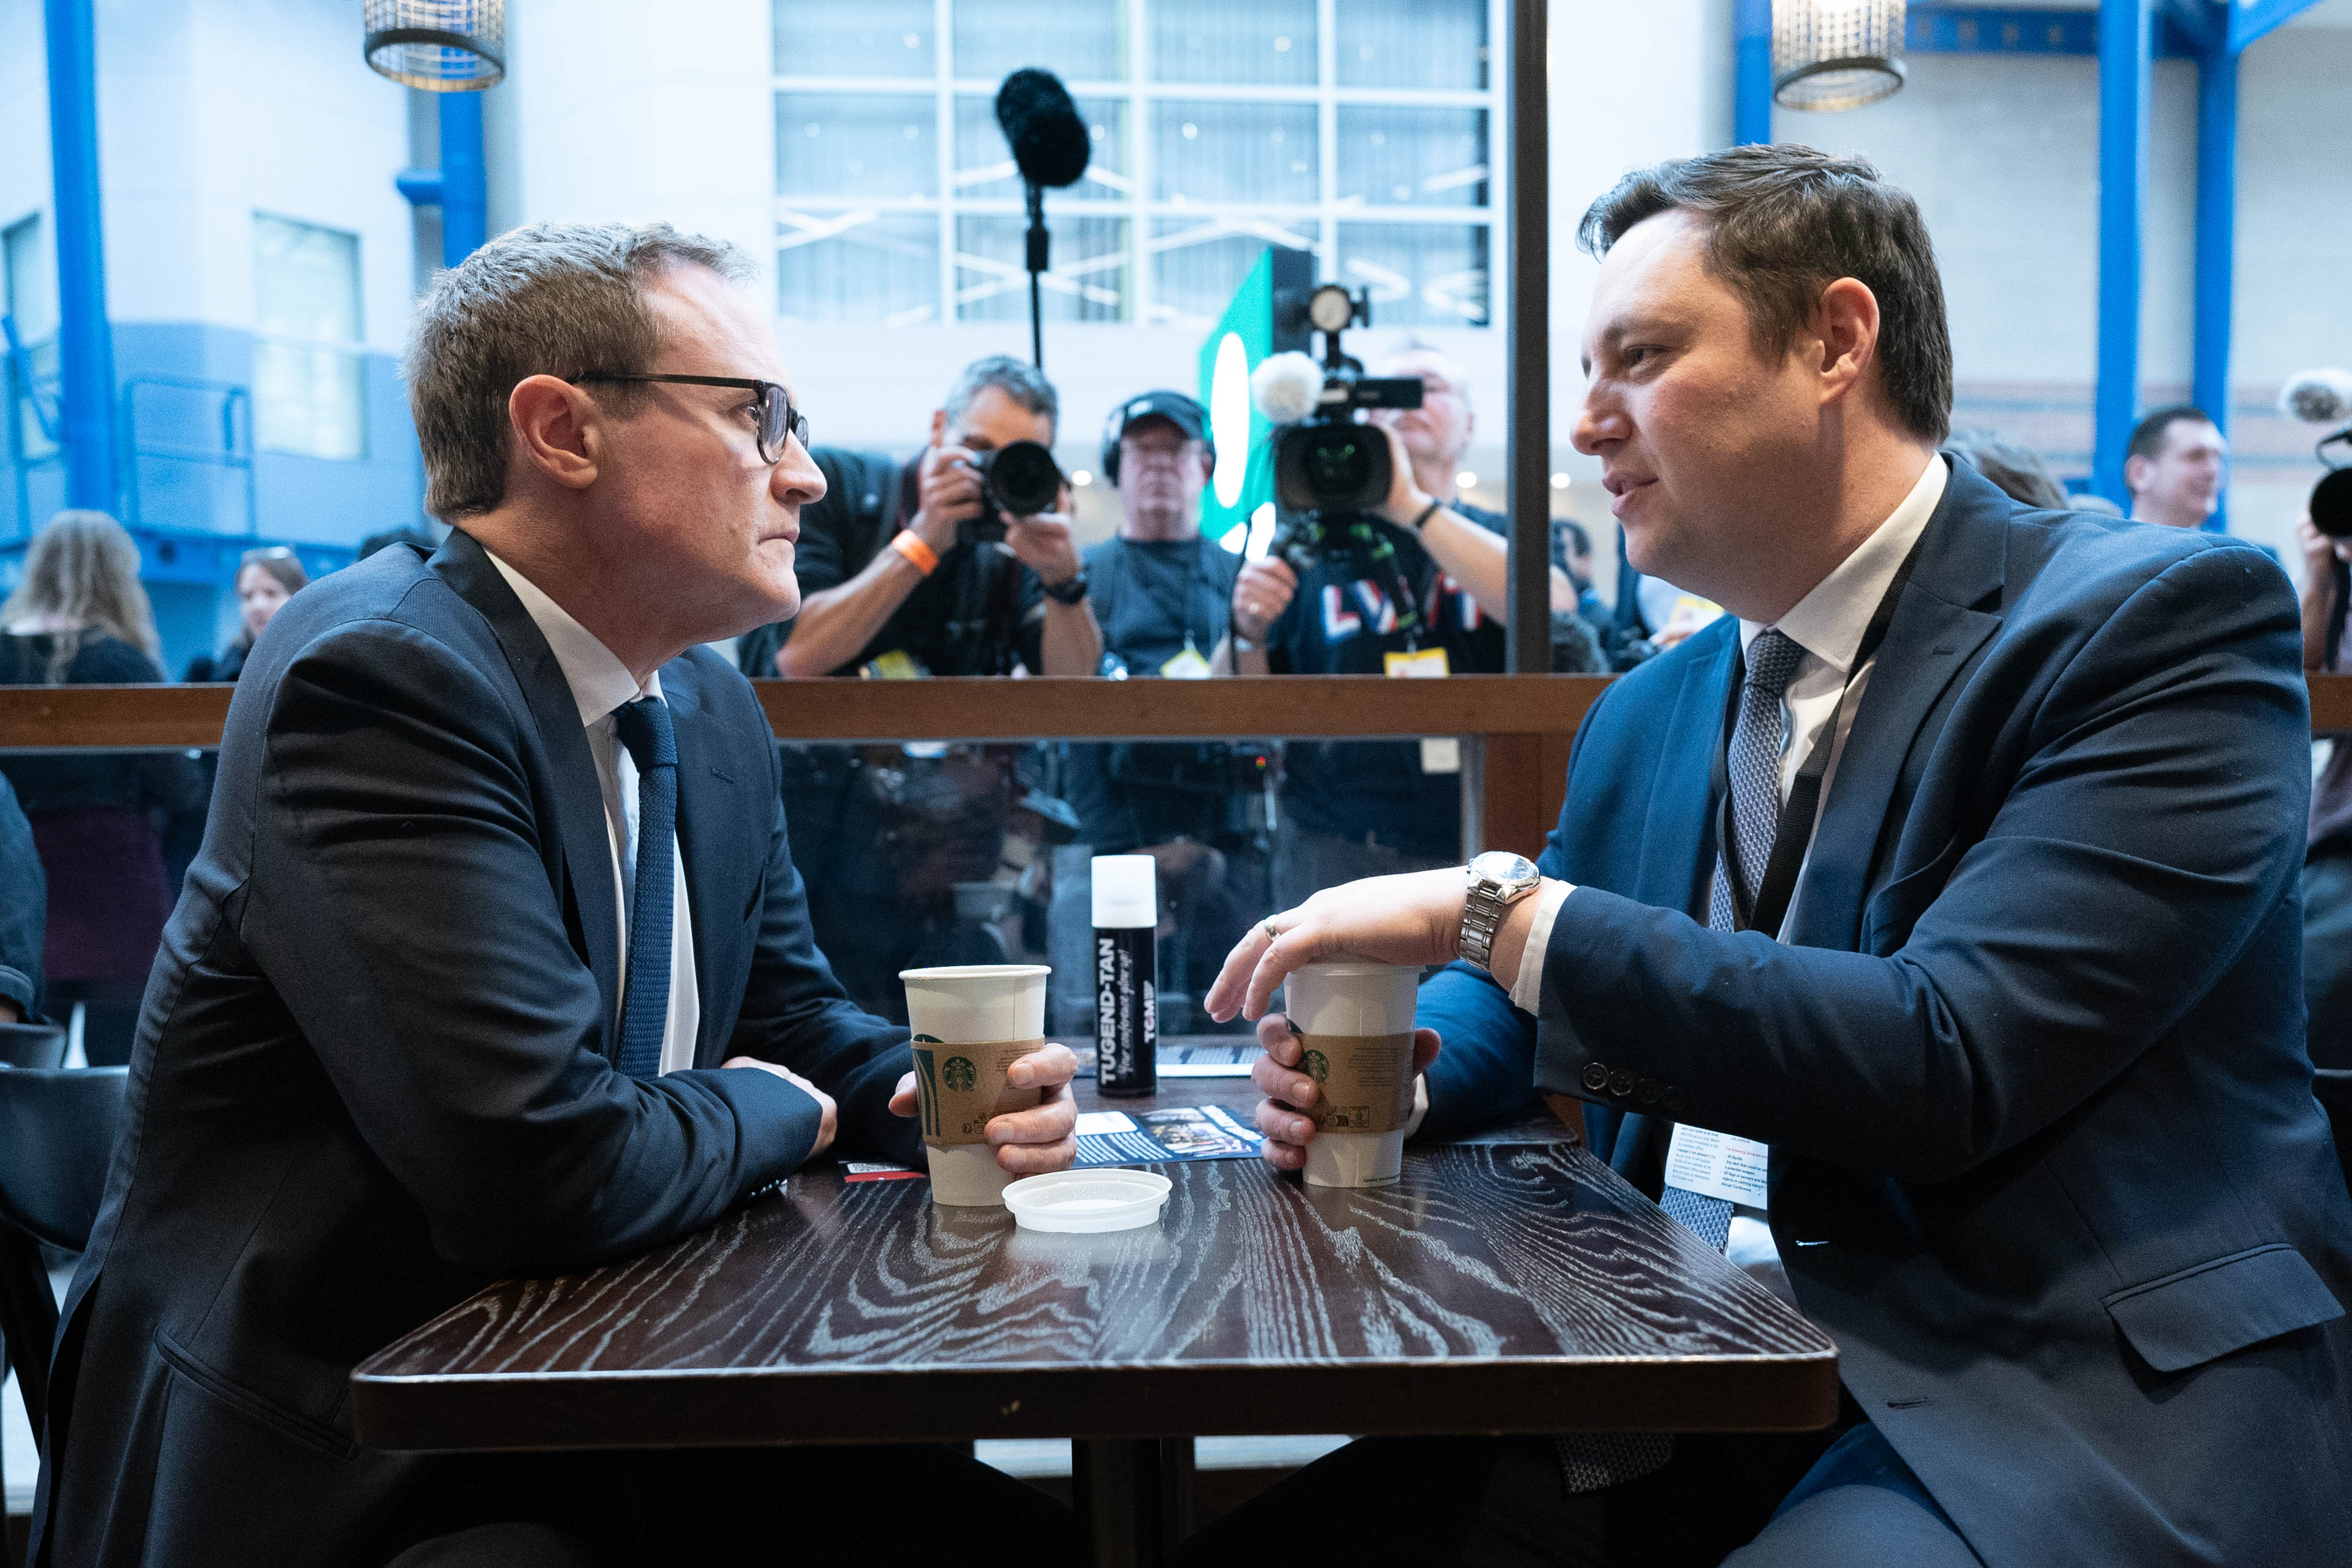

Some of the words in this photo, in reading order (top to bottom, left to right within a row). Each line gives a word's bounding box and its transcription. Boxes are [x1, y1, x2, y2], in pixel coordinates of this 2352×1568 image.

[1099, 938, 1116, 1085] TUGEND-TAN
[1144, 999, 1155, 1043] TOM
[1118, 1049, 1134, 1076] Your
